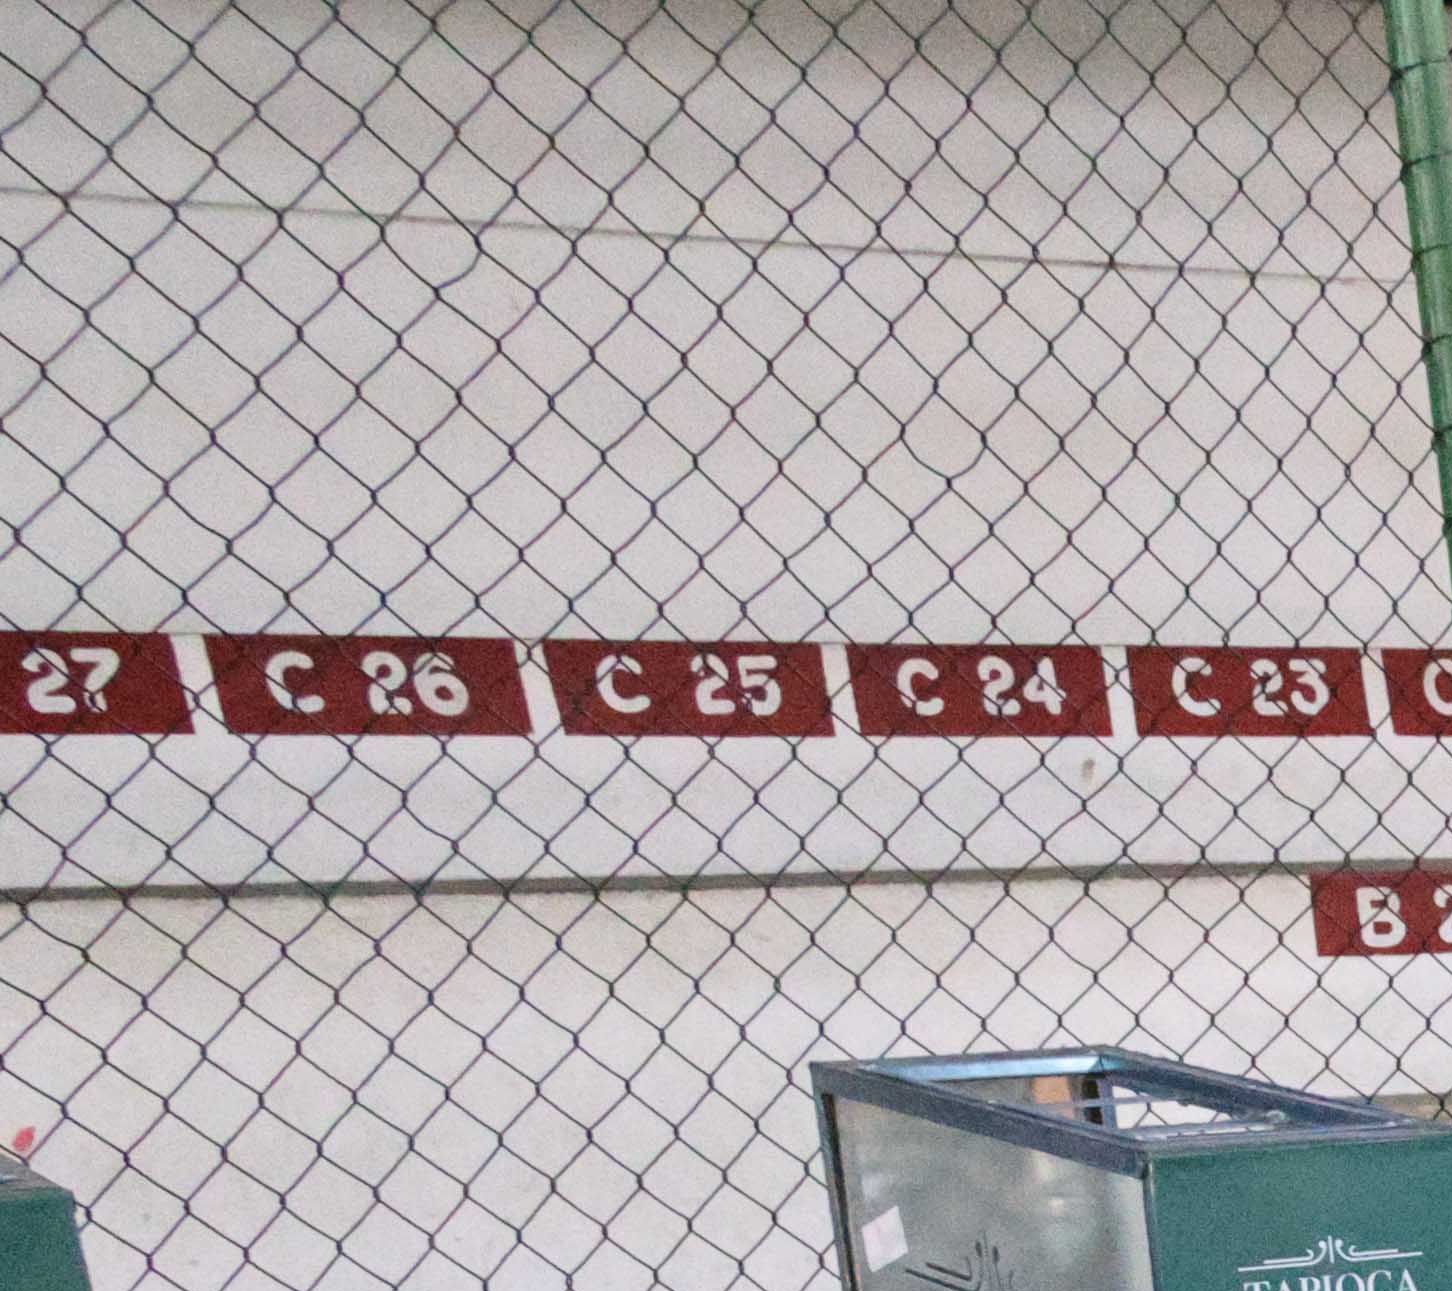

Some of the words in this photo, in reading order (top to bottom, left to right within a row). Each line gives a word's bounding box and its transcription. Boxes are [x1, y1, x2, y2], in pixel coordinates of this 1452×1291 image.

[22, 648, 120, 713] 27
[265, 651, 325, 713] C
[362, 651, 469, 716] 26
[596, 656, 650, 713] C
[691, 654, 781, 716] 25
[897, 659, 944, 716] C
[978, 656, 1066, 715] 24
[1172, 658, 1220, 716] C
[1251, 659, 1329, 715] 23
[1356, 887, 1406, 947] B
